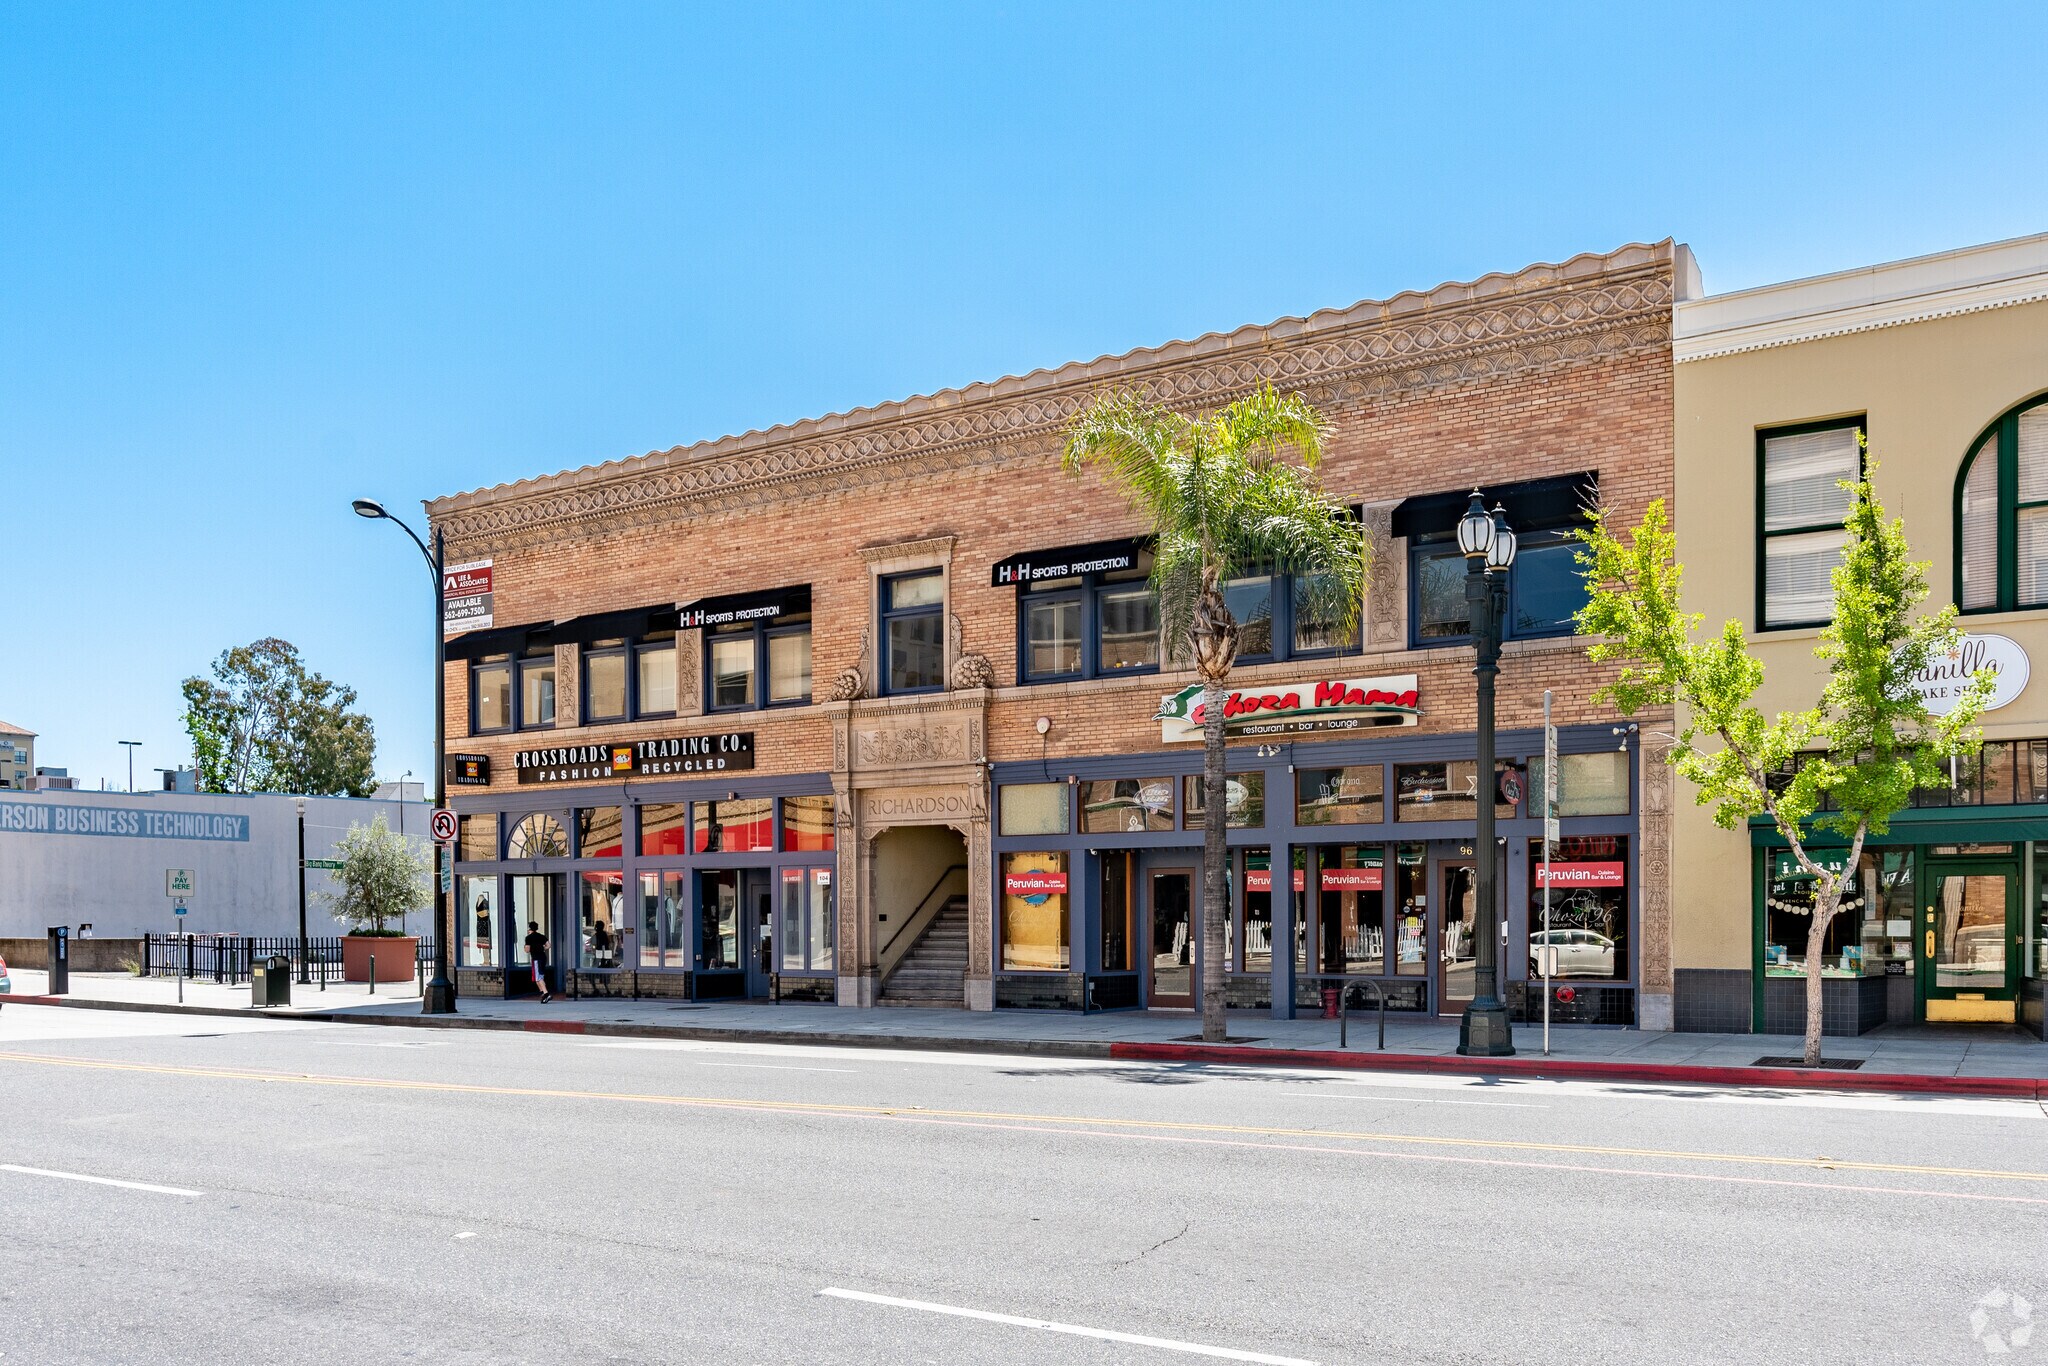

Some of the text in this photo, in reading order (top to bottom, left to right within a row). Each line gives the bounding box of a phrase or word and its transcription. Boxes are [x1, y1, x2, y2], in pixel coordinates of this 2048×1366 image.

[999, 556, 1129, 583] H&H SPORTS PROTECTION
[459, 577, 488, 588] ASSOCIATES
[448, 596, 482, 610] AVAILABLE
[444, 606, 486, 620] 562-699-7500
[680, 606, 780, 628] H&H SPORTS PROTECTION
[1314, 680, 1420, 708] Mama
[1920, 686, 1948, 699] AKE
[1242, 718, 1358, 734] restaurant bar lounge
[513, 734, 748, 769] CROSSROADS TRADING CO.
[540, 758, 726, 782] FASHION RECYCLED
[868, 796, 970, 815] RICHARDSON
[55, 807, 139, 834] BUSINESS
[144, 812, 242, 838] TECHNOLOGY
[1460, 846, 1473, 856] 96
[1248, 876, 1271, 885] Peruv
[1322, 874, 1360, 884] Peruvian
[1538, 868, 1590, 880] Peruvian
[1007, 878, 1044, 888] Peruvian
